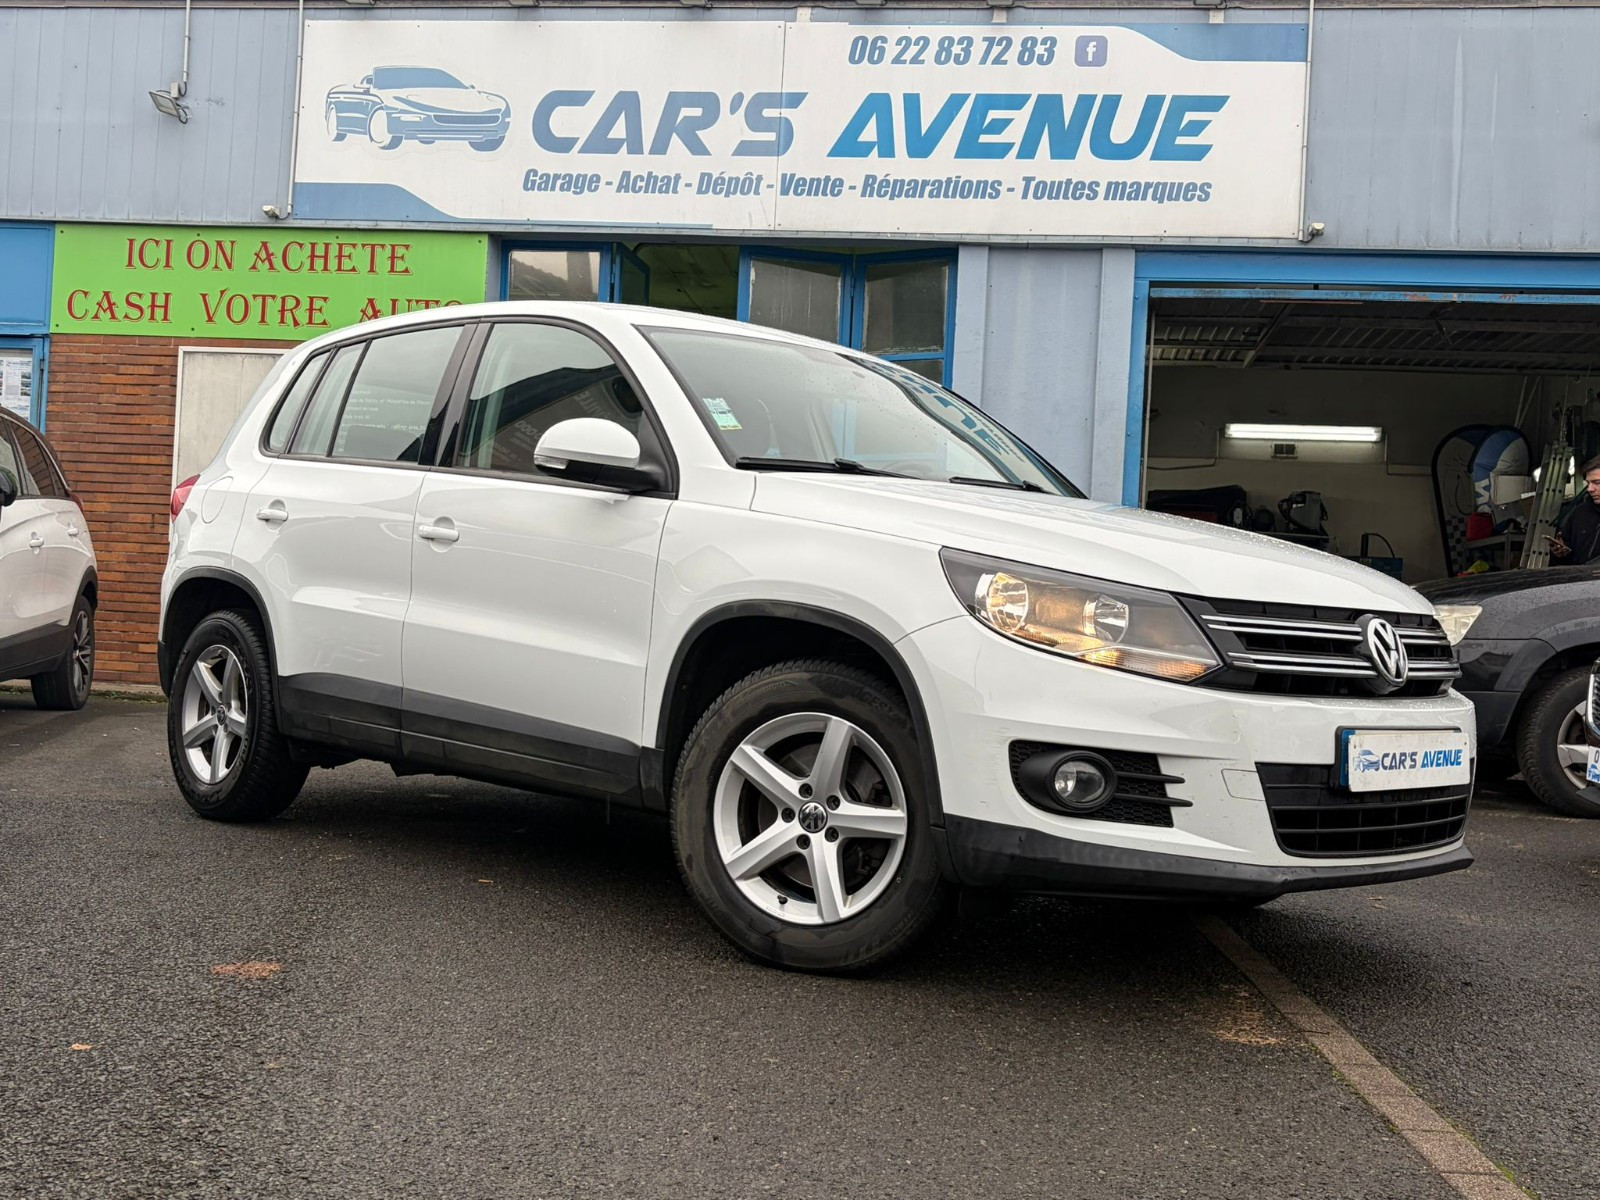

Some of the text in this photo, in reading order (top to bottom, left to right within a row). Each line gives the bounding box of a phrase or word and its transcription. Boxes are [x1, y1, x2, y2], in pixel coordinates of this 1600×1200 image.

[848, 35, 1058, 65] 06 22 83 72 83
[531, 90, 1231, 161] CAR'S AVENUE
[522, 168, 600, 195] Garage
[616, 170, 681, 194] Achat
[696, 171, 763, 198] Dépôt
[779, 172, 845, 197] Vente
[860, 174, 1002, 201] Réparations
[1021, 176, 1100, 201] Toutes
[1103, 179, 1212, 204] marques
[125, 238, 413, 275] ICI ON ACHETE
[67, 287, 464, 329] CASH VOTRE AUT
[1381, 748, 1464, 771] CAR'S AVENUE
